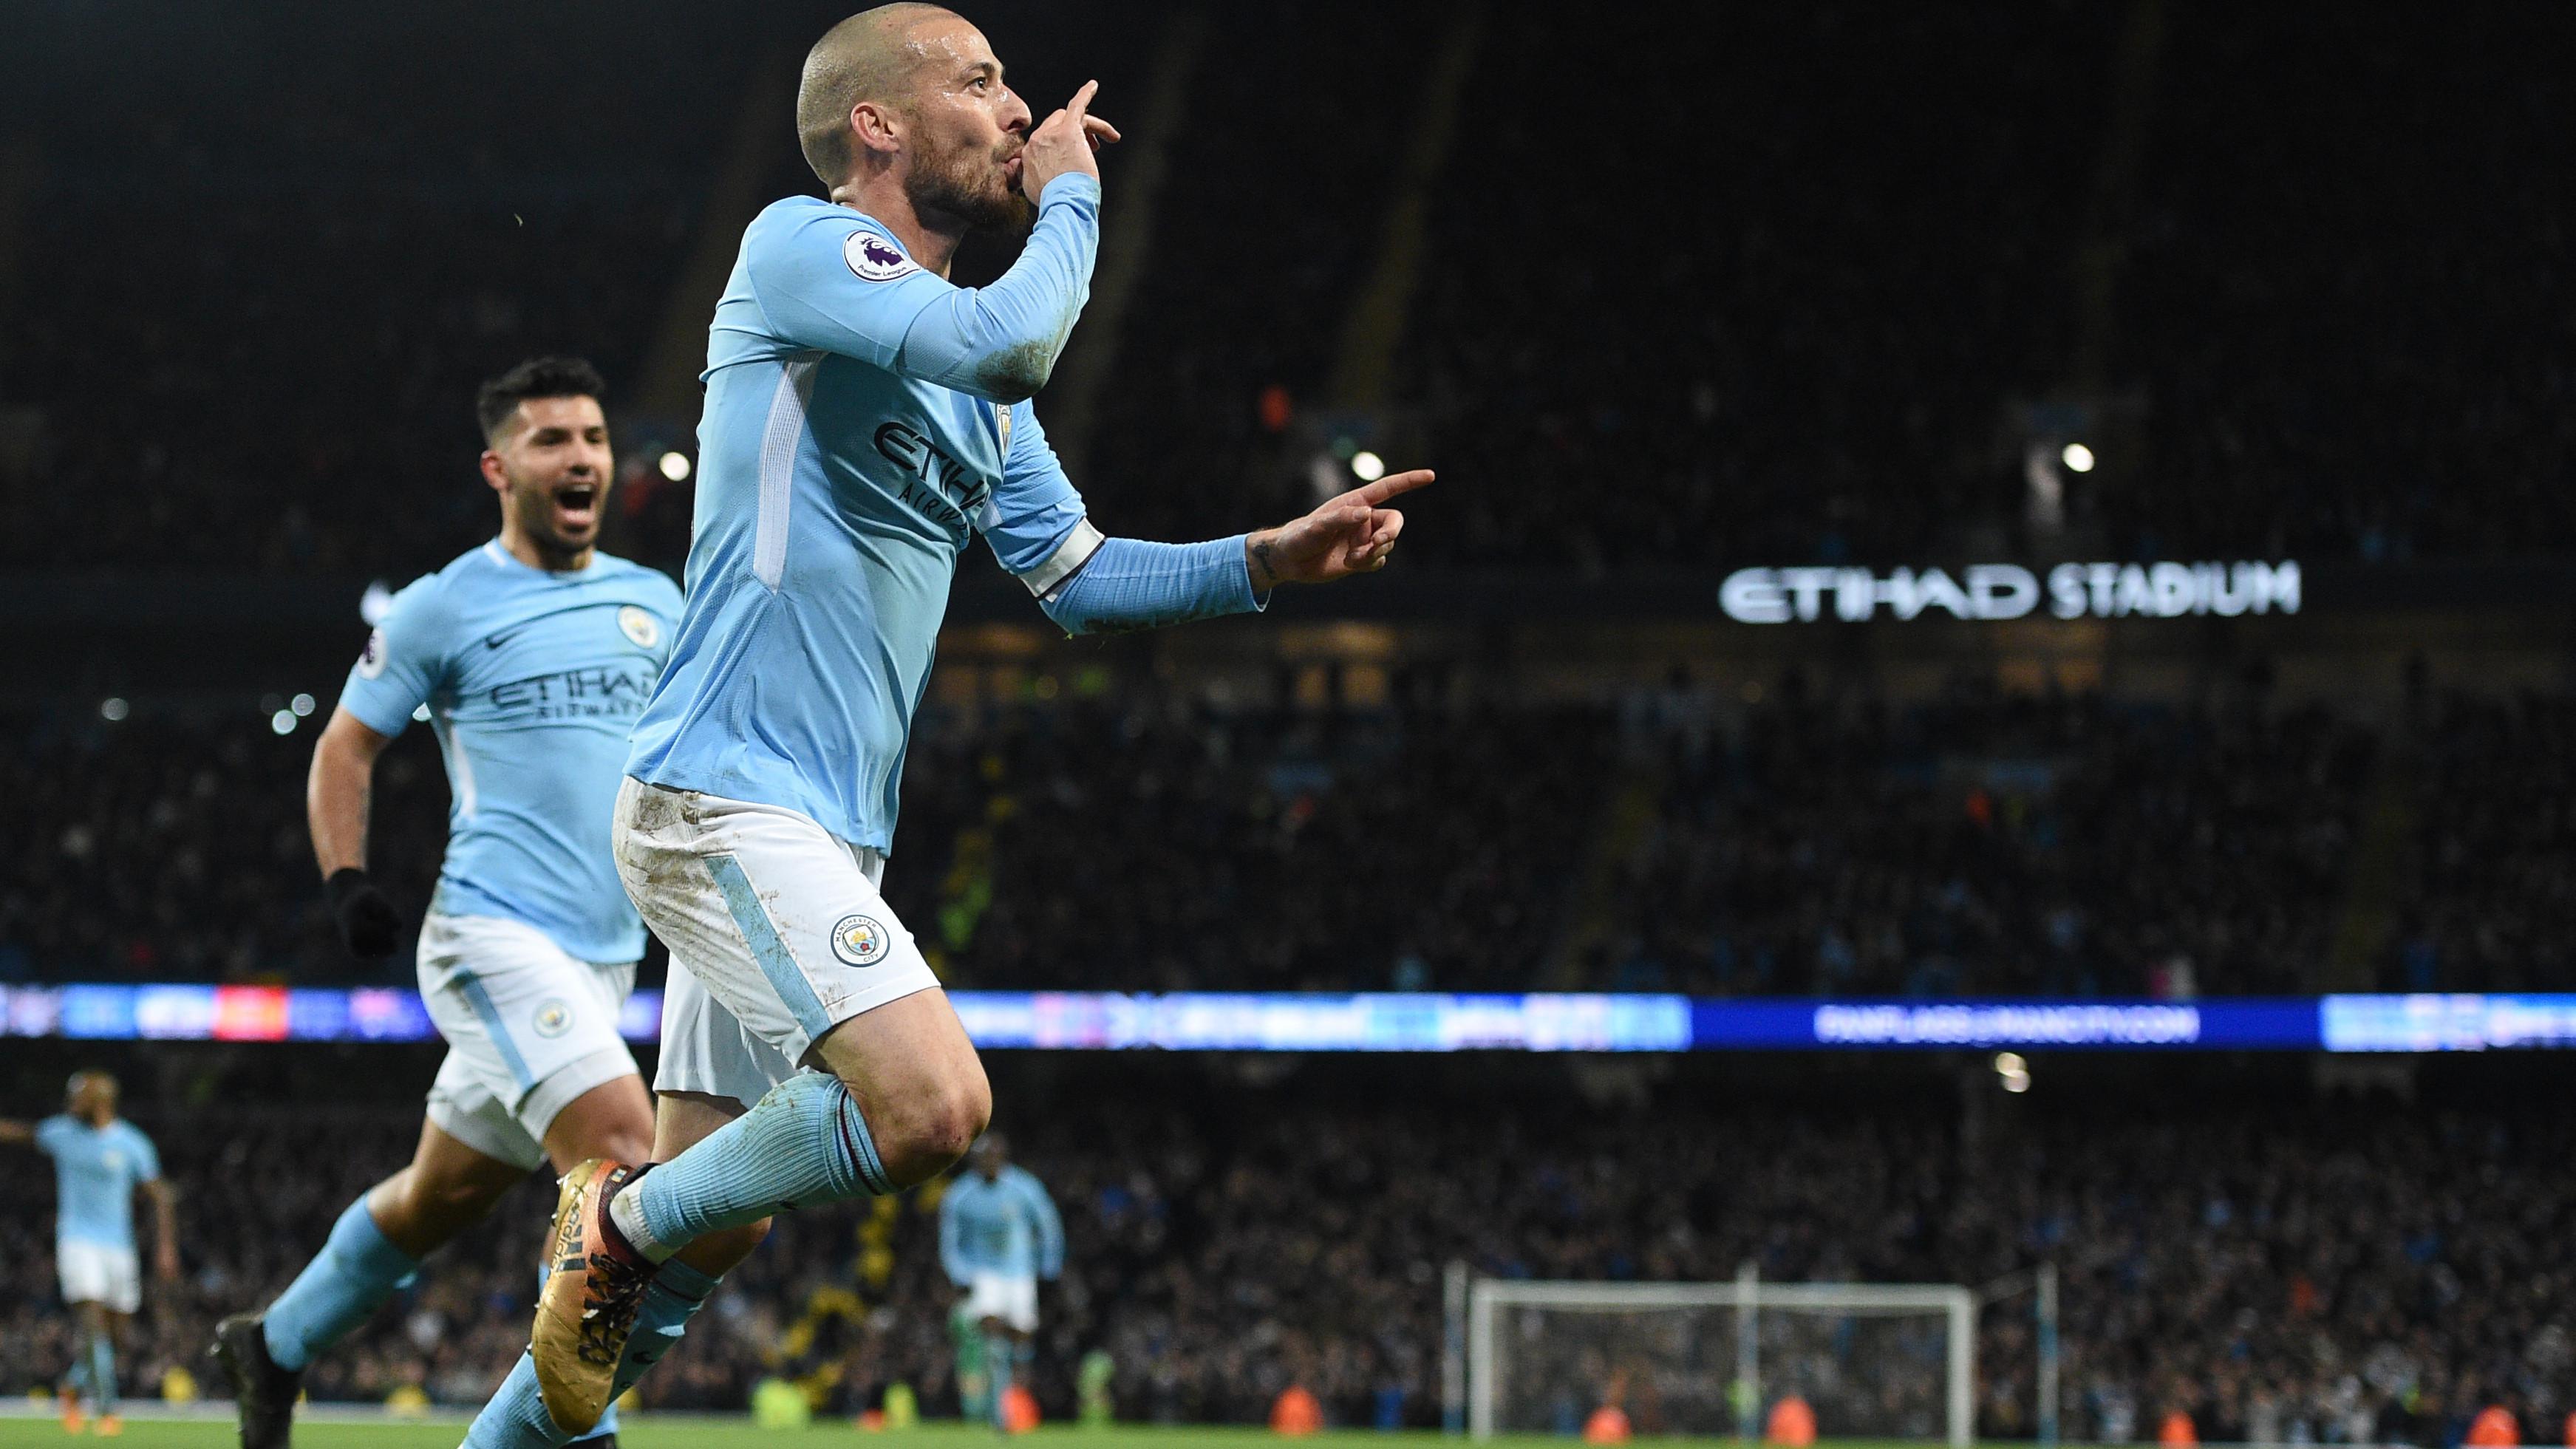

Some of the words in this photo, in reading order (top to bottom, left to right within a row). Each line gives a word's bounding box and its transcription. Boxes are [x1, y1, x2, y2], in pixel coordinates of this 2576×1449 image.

[858, 264, 882, 276] Premier
[883, 266, 907, 276] League
[874, 420, 989, 512] ETIH
[898, 483, 965, 528] AIRW
[1720, 565, 2040, 624] ETIHAD
[2047, 560, 2302, 619] STADIUM
[836, 918, 877, 942] MANCHESTER
[863, 953, 879, 963] CITY
